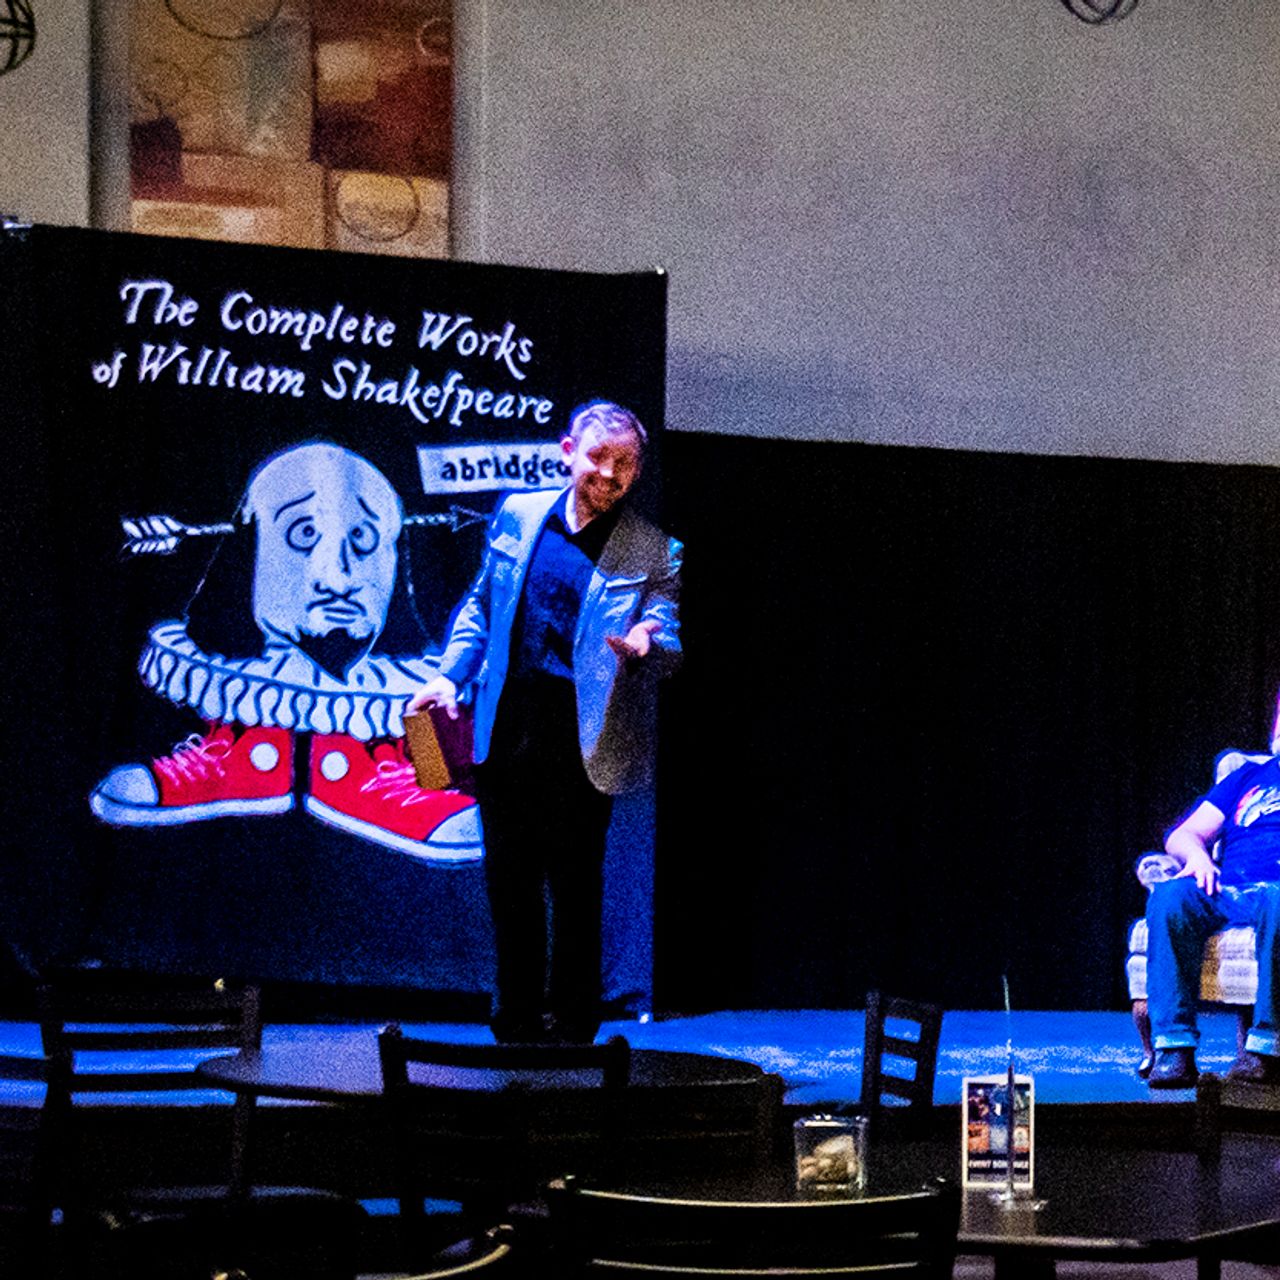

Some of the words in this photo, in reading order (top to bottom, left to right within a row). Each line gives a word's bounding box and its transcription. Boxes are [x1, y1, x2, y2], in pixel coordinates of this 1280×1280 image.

[92, 351, 128, 389] of
[138, 341, 306, 398] William
[119, 279, 199, 327] The
[219, 291, 397, 352] Complete
[417, 310, 535, 381] Works
